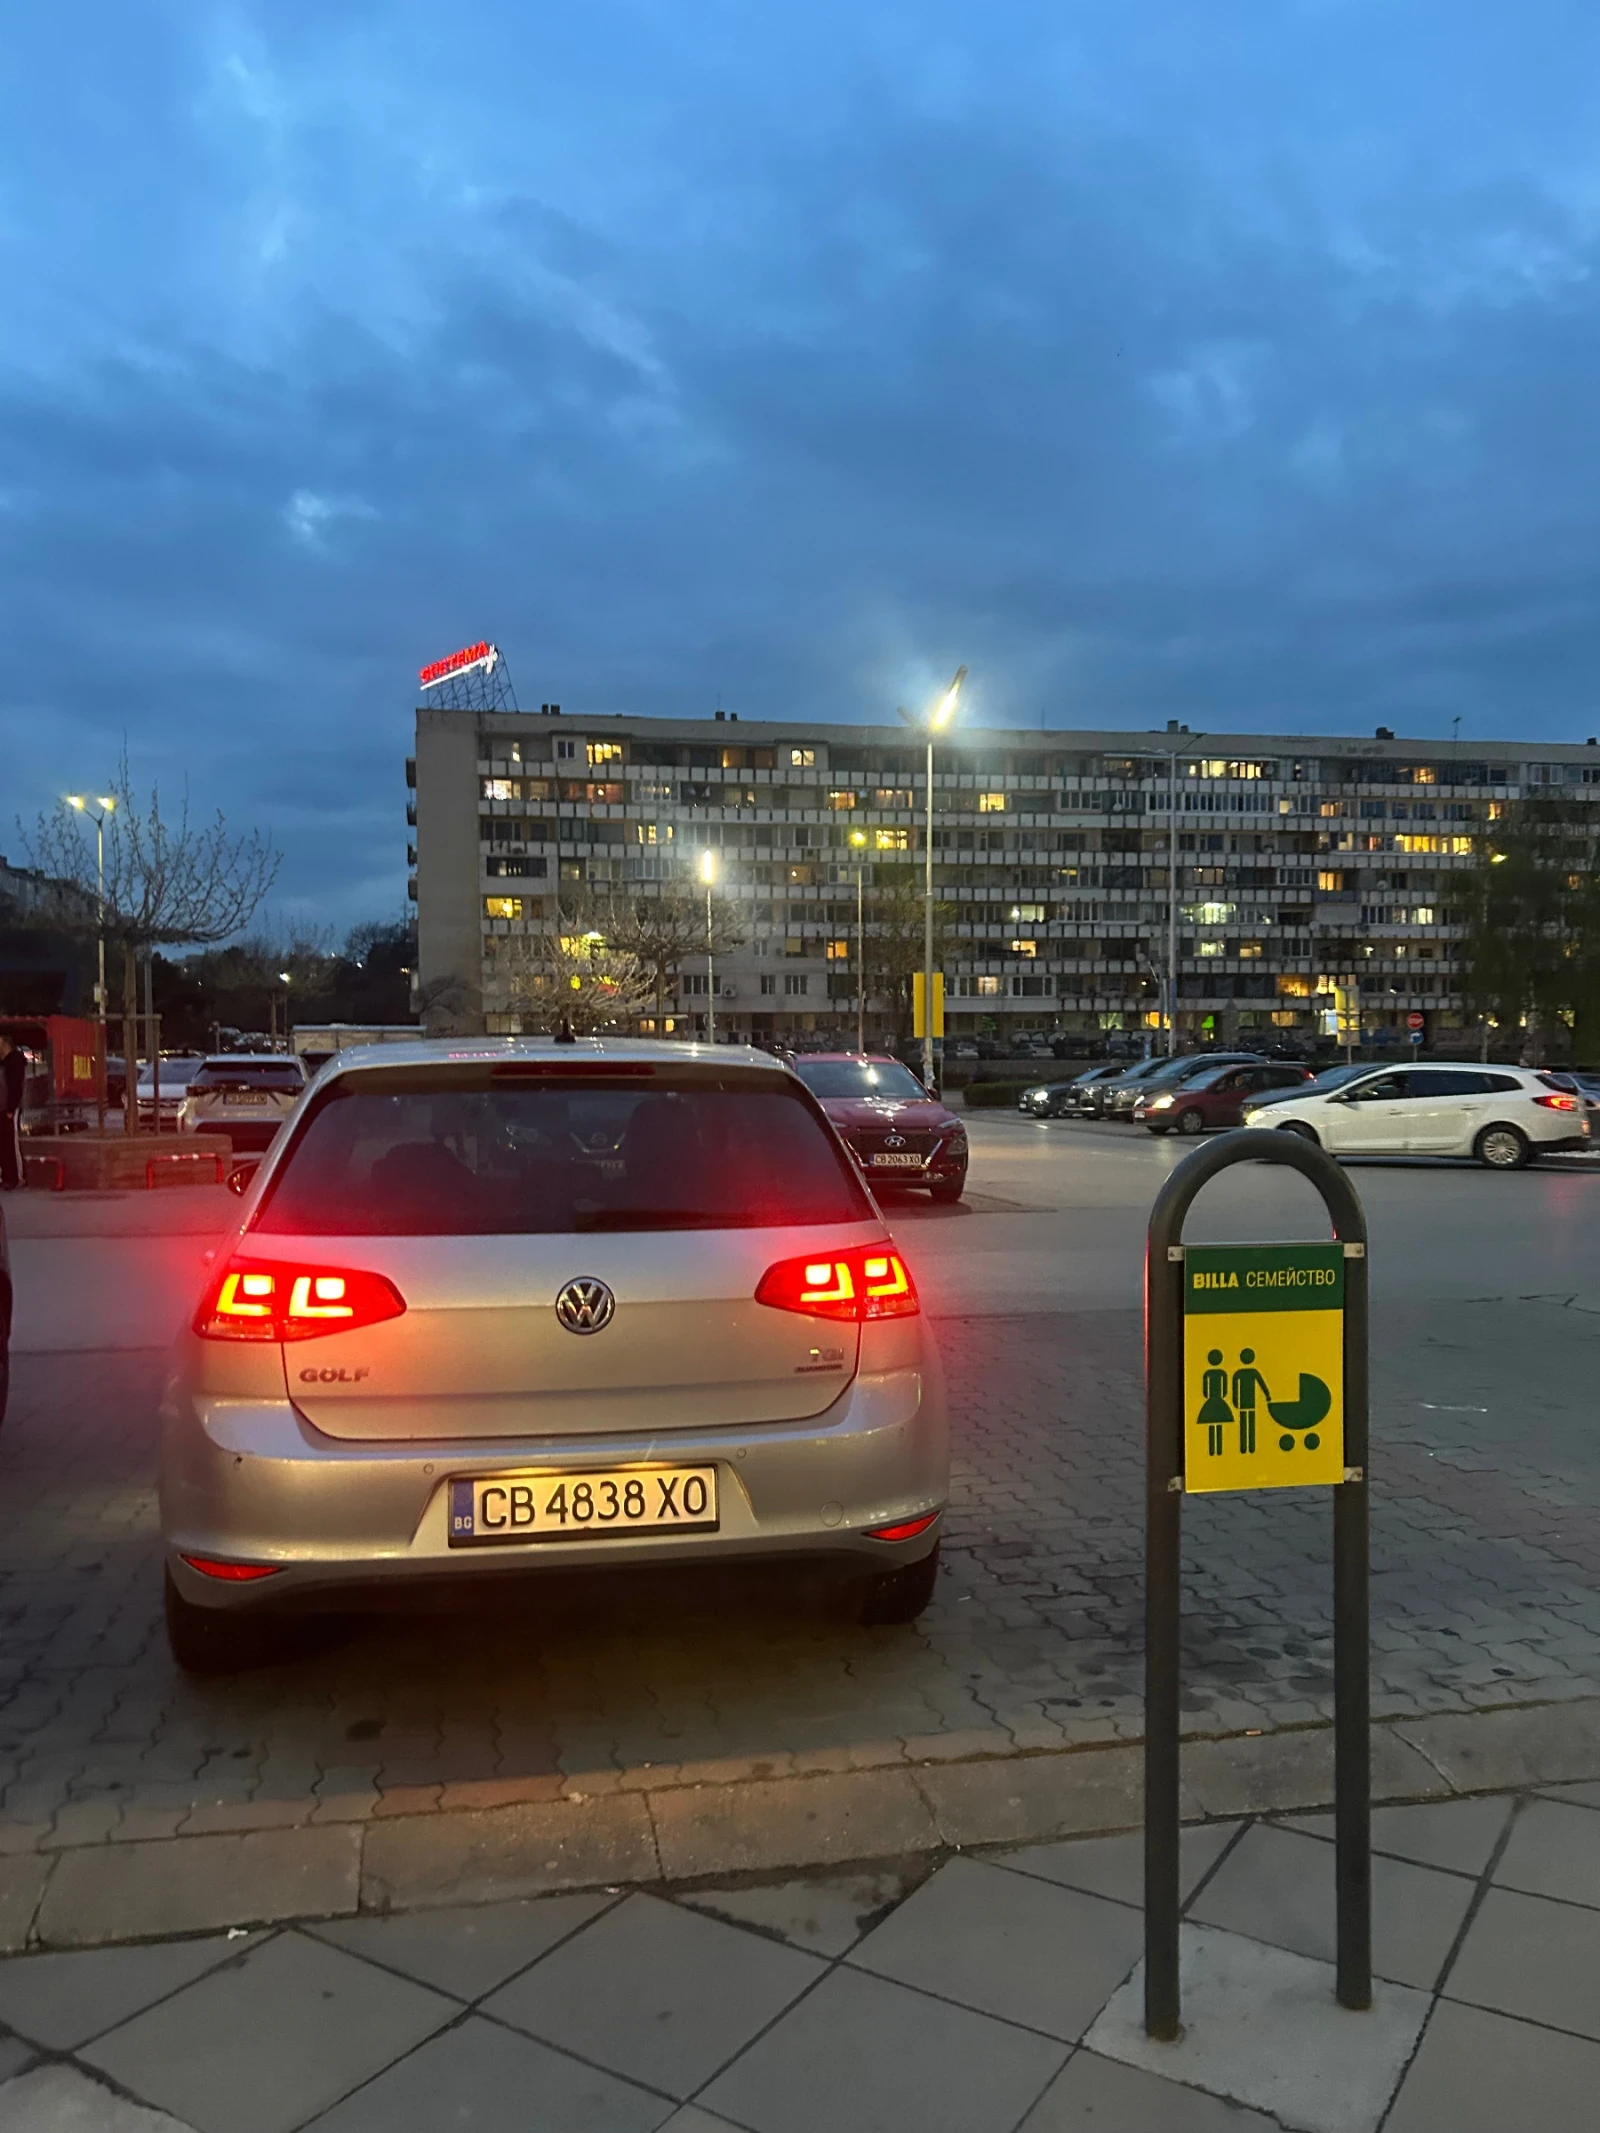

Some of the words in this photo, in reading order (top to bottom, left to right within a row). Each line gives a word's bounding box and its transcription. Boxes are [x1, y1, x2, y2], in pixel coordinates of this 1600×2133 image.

[1193, 1272, 1240, 1289] BILLA
[1246, 1267, 1336, 1288] СЕМЕЙСТВО
[299, 1367, 370, 1382] GOLF
[481, 1487, 536, 1528] CB
[546, 1479, 646, 1524] 4838
[656, 1475, 707, 1519] XO
[454, 1518, 472, 1530] BG
